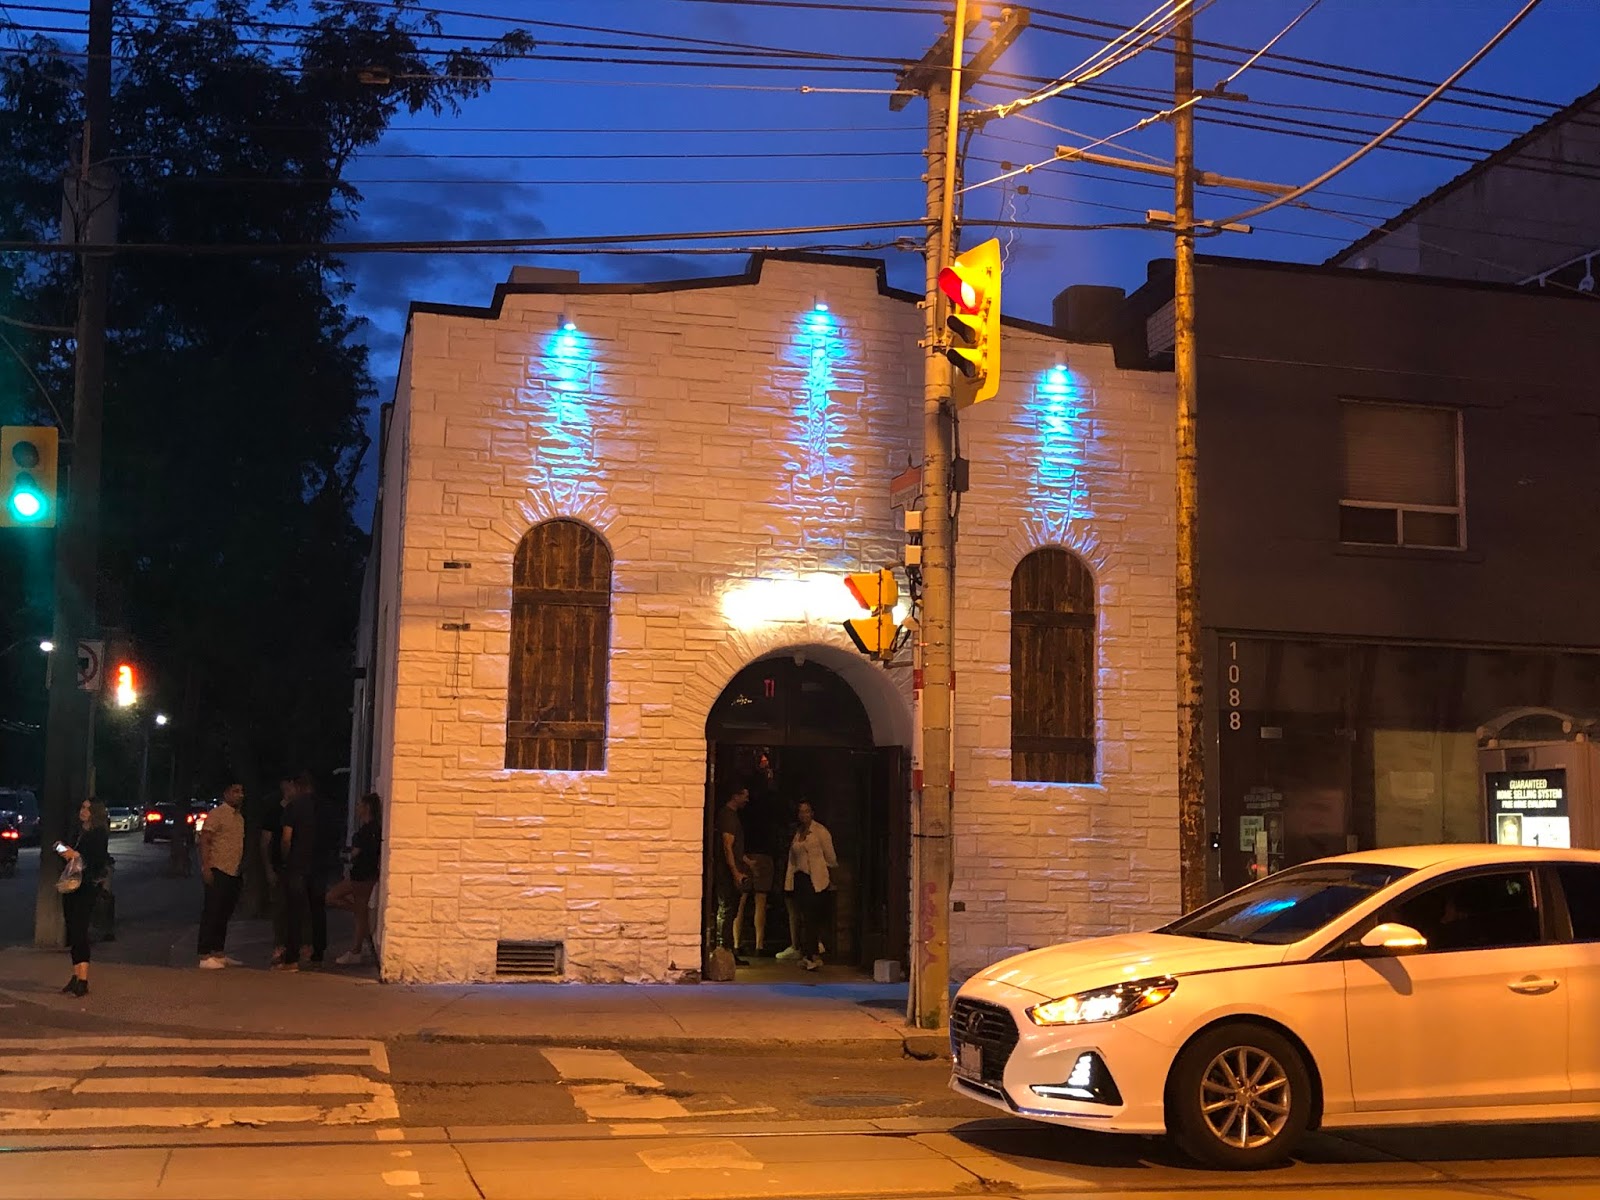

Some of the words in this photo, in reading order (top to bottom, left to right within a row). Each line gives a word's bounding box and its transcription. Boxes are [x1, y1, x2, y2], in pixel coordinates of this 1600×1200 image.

[1229, 641, 1241, 730] 1088
[1510, 779, 1547, 789] GUARANTEED
[1513, 789, 1537, 799] SELLING
[1537, 788, 1563, 799] SYSTEM
